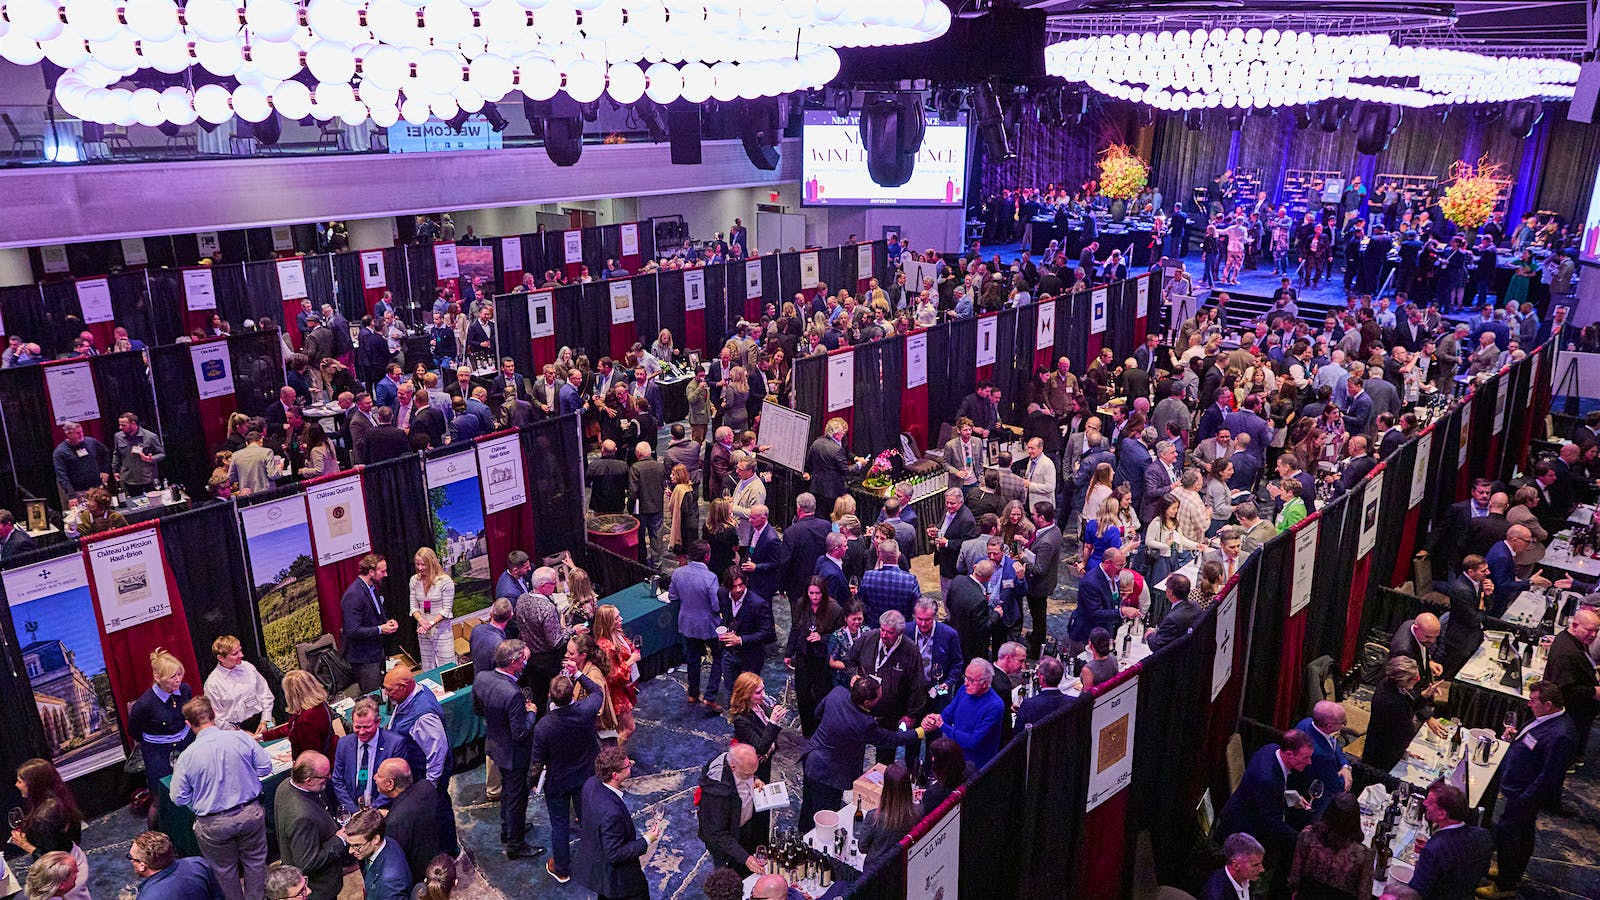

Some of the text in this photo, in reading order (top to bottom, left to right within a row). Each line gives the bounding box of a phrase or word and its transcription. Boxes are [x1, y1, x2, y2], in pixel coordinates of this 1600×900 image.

[831, 116, 849, 125] NEW
[316, 485, 355, 500] Château Quintus
[97, 539, 153, 559] Château La Mission
[352, 541, 365, 551] 6324
[110, 550, 143, 563] Haut-Brion
[148, 603, 164, 614] 6323
